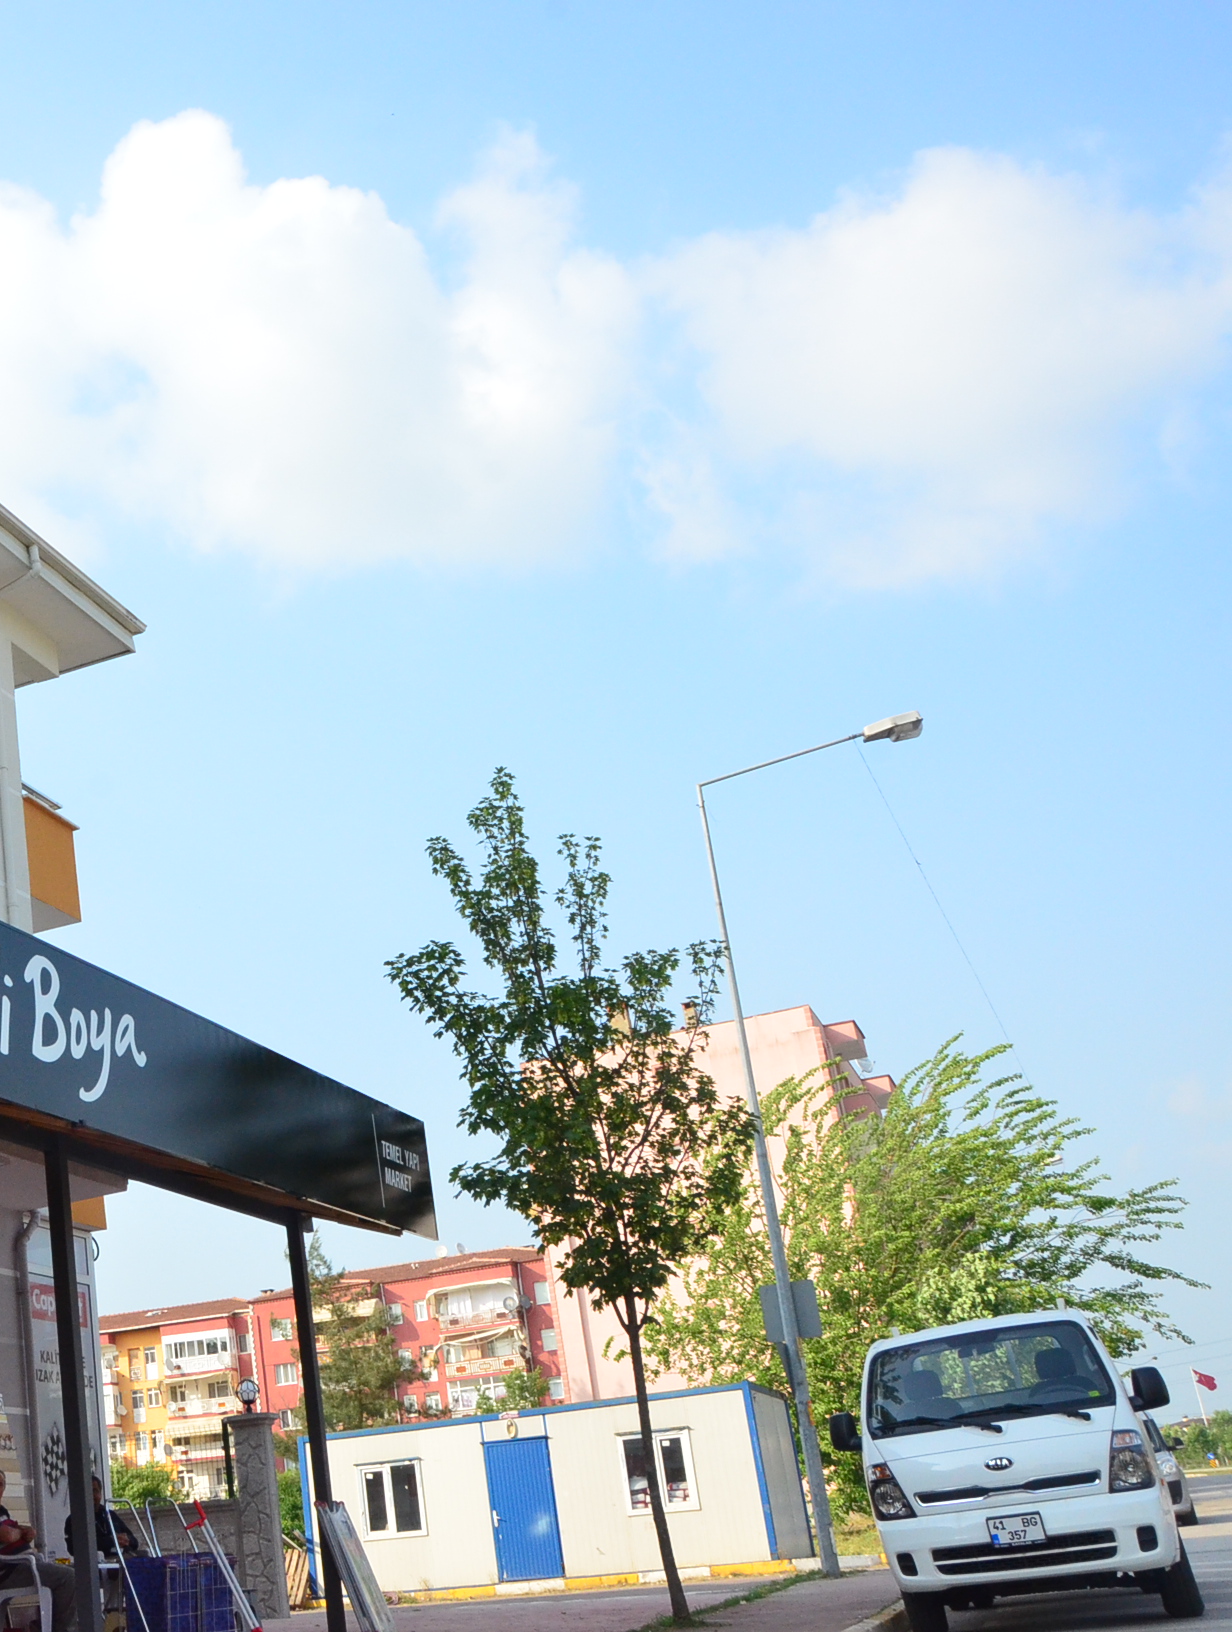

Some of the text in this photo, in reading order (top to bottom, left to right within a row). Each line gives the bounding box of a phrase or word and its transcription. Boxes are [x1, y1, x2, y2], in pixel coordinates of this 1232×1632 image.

[24, 954, 147, 1102] Boya
[381, 1140, 420, 1172] TEMEL YAPI
[384, 1166, 412, 1193] MARKET
[992, 1516, 1038, 1531] 41 BG
[1007, 1529, 1027, 1541] 357
